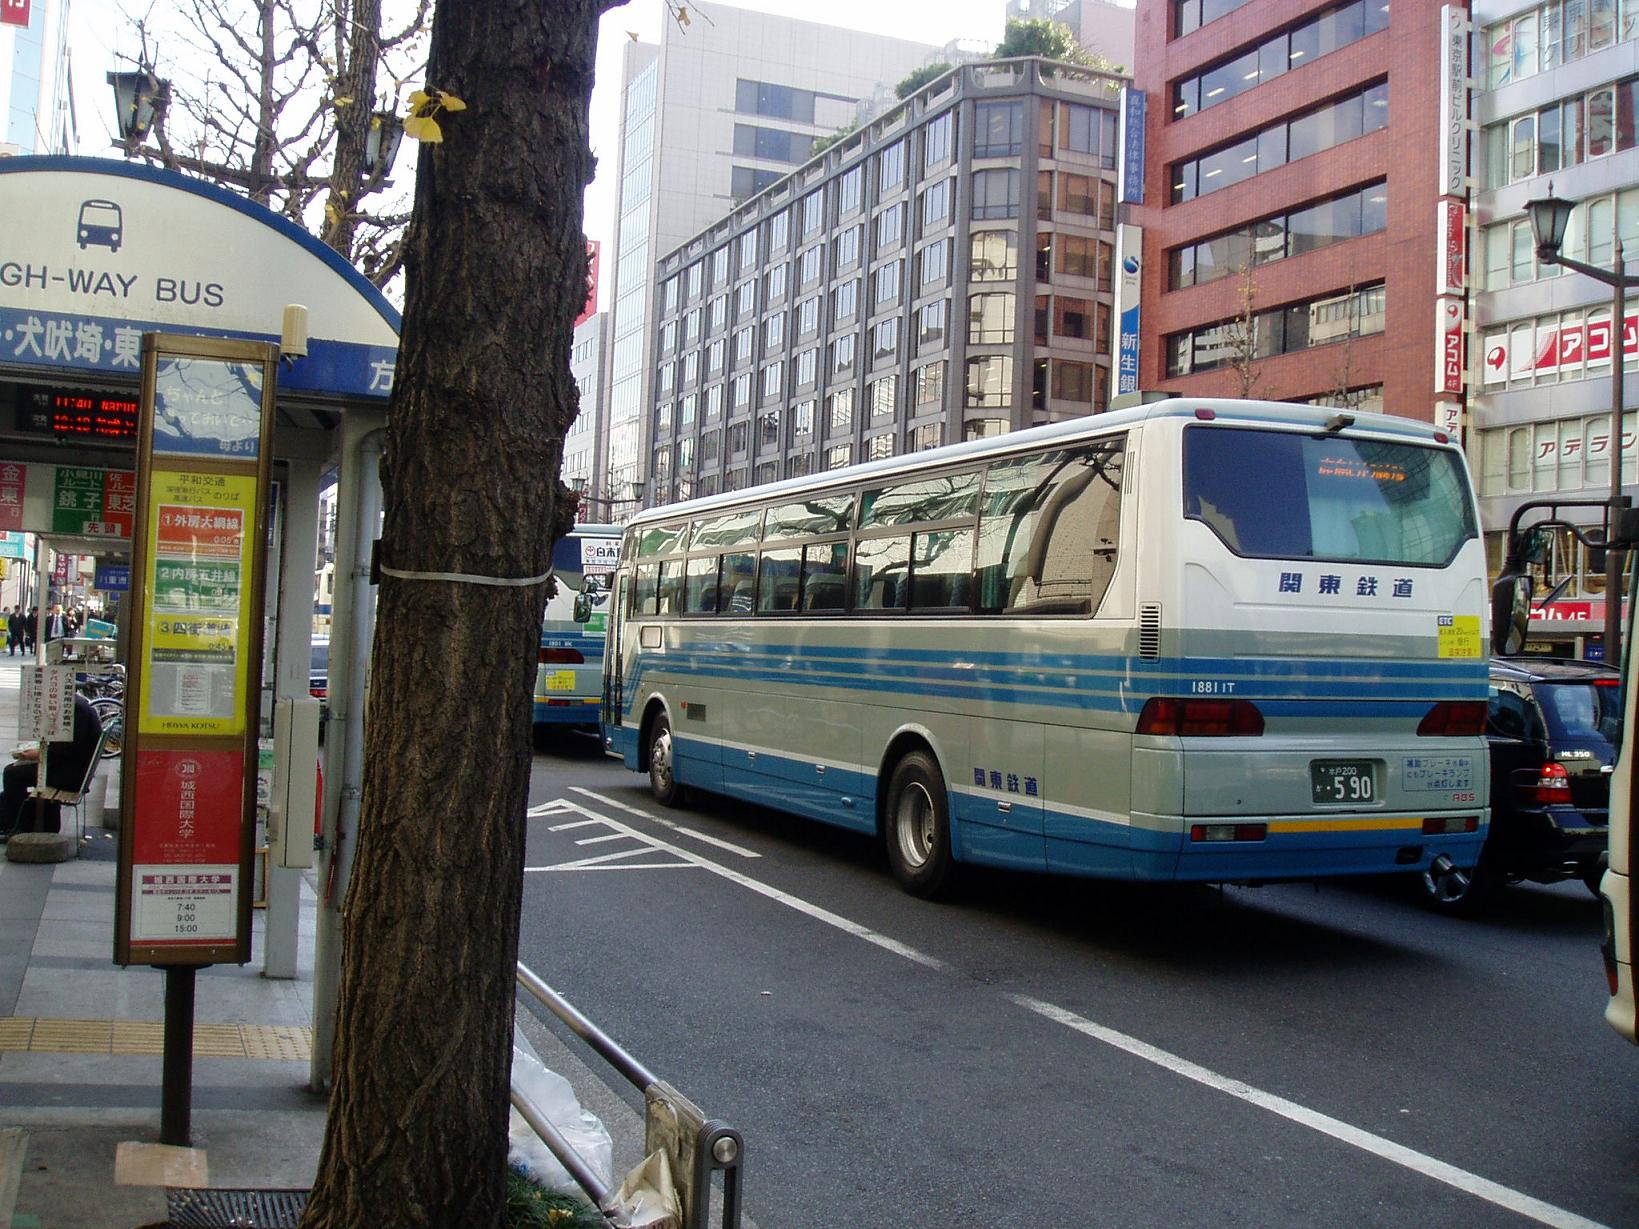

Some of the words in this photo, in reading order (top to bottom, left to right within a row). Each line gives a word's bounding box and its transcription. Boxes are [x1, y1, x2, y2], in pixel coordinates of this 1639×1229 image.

[0, 262, 138, 297] GH-WAY
[155, 279, 224, 306] BUS
[1447, 334, 1459, 377] アコム
[1278, 572, 1414, 598] 関東鉄道
[1439, 616, 1453, 625] ETC
[974, 767, 1038, 797] 関東鉄道
[177, 903, 196, 911] 7:40
[177, 914, 196, 922] 9:00
[175, 925, 198, 933] 15:00
